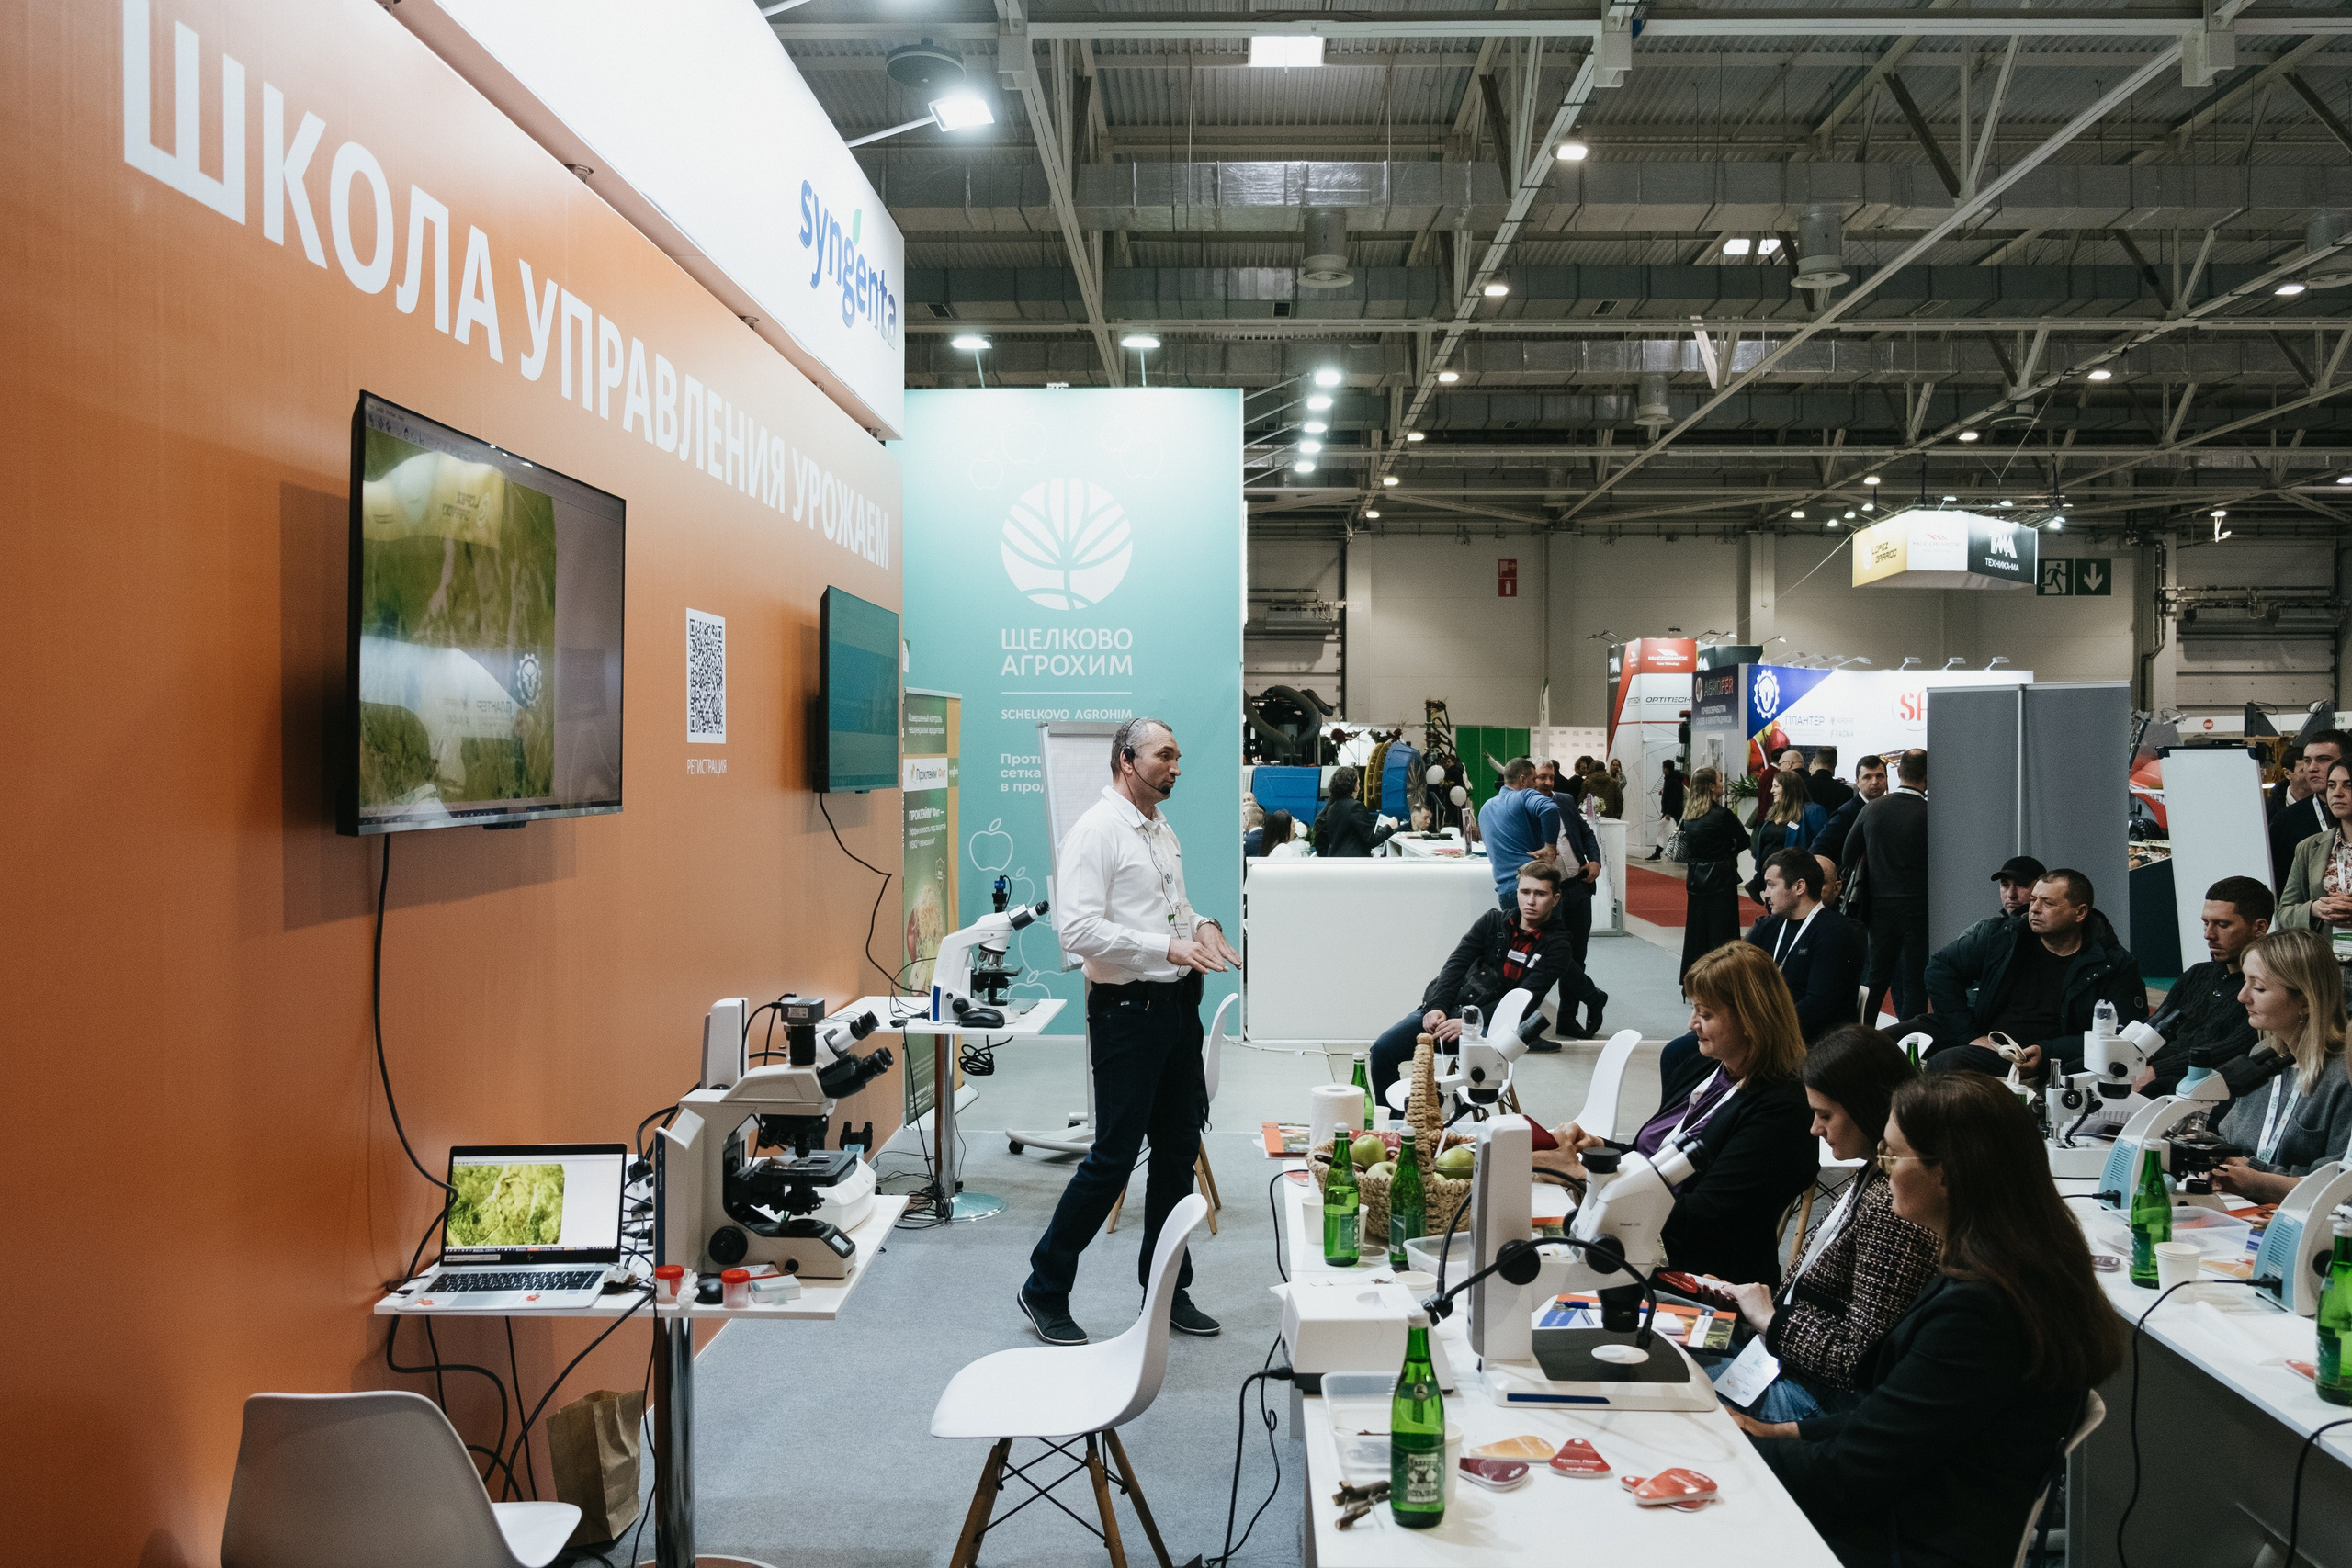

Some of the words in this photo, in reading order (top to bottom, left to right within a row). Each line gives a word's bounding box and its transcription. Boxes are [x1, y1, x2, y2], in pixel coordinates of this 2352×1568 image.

[799, 179, 898, 350] syngenta
[124, 0, 503, 364] ШКОЛА
[518, 258, 786, 515] УПРАВЛЕНИЯ
[791, 446, 890, 571] УРОЖАЕМ
[1984, 558, 2019, 572] ТЕХНИКА-МА
[1001, 628, 1133, 652] ЩЕЛКОВО
[1001, 655, 1133, 676] АГРОХИМ
[1001, 708, 1069, 720] SCHELKOVO
[1075, 708, 1133, 720] AGROHIM
[1785, 715, 1825, 726] ПЛАНТЕР
[687, 759, 727, 777] РЕГИСТРАЦИЯ
[1001, 769, 1042, 778] сетка
[1001, 783, 1009, 792] в
